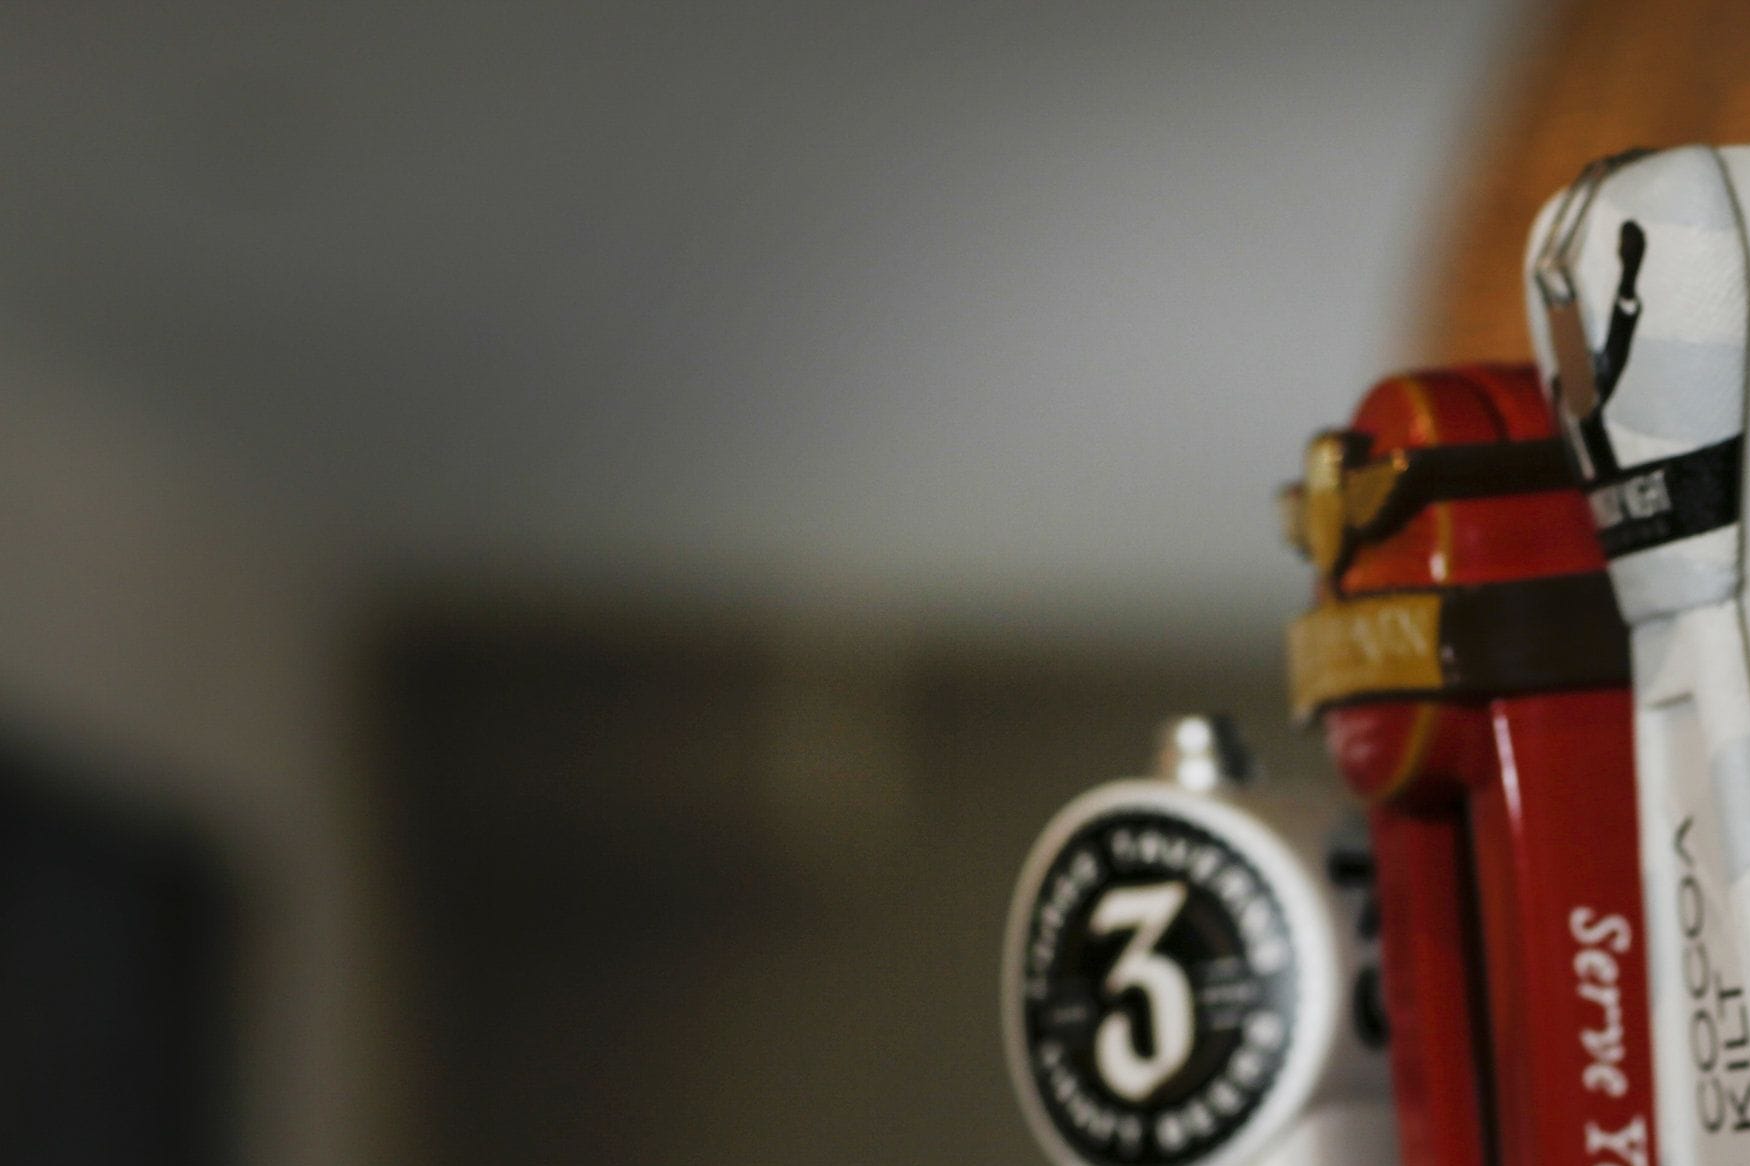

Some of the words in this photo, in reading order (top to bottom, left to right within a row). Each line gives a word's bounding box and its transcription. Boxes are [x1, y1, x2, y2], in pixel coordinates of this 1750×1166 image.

[1088, 881, 1196, 1101] 3
[1569, 906, 1632, 1097] Serve
[1673, 816, 1727, 1134] COCOA
